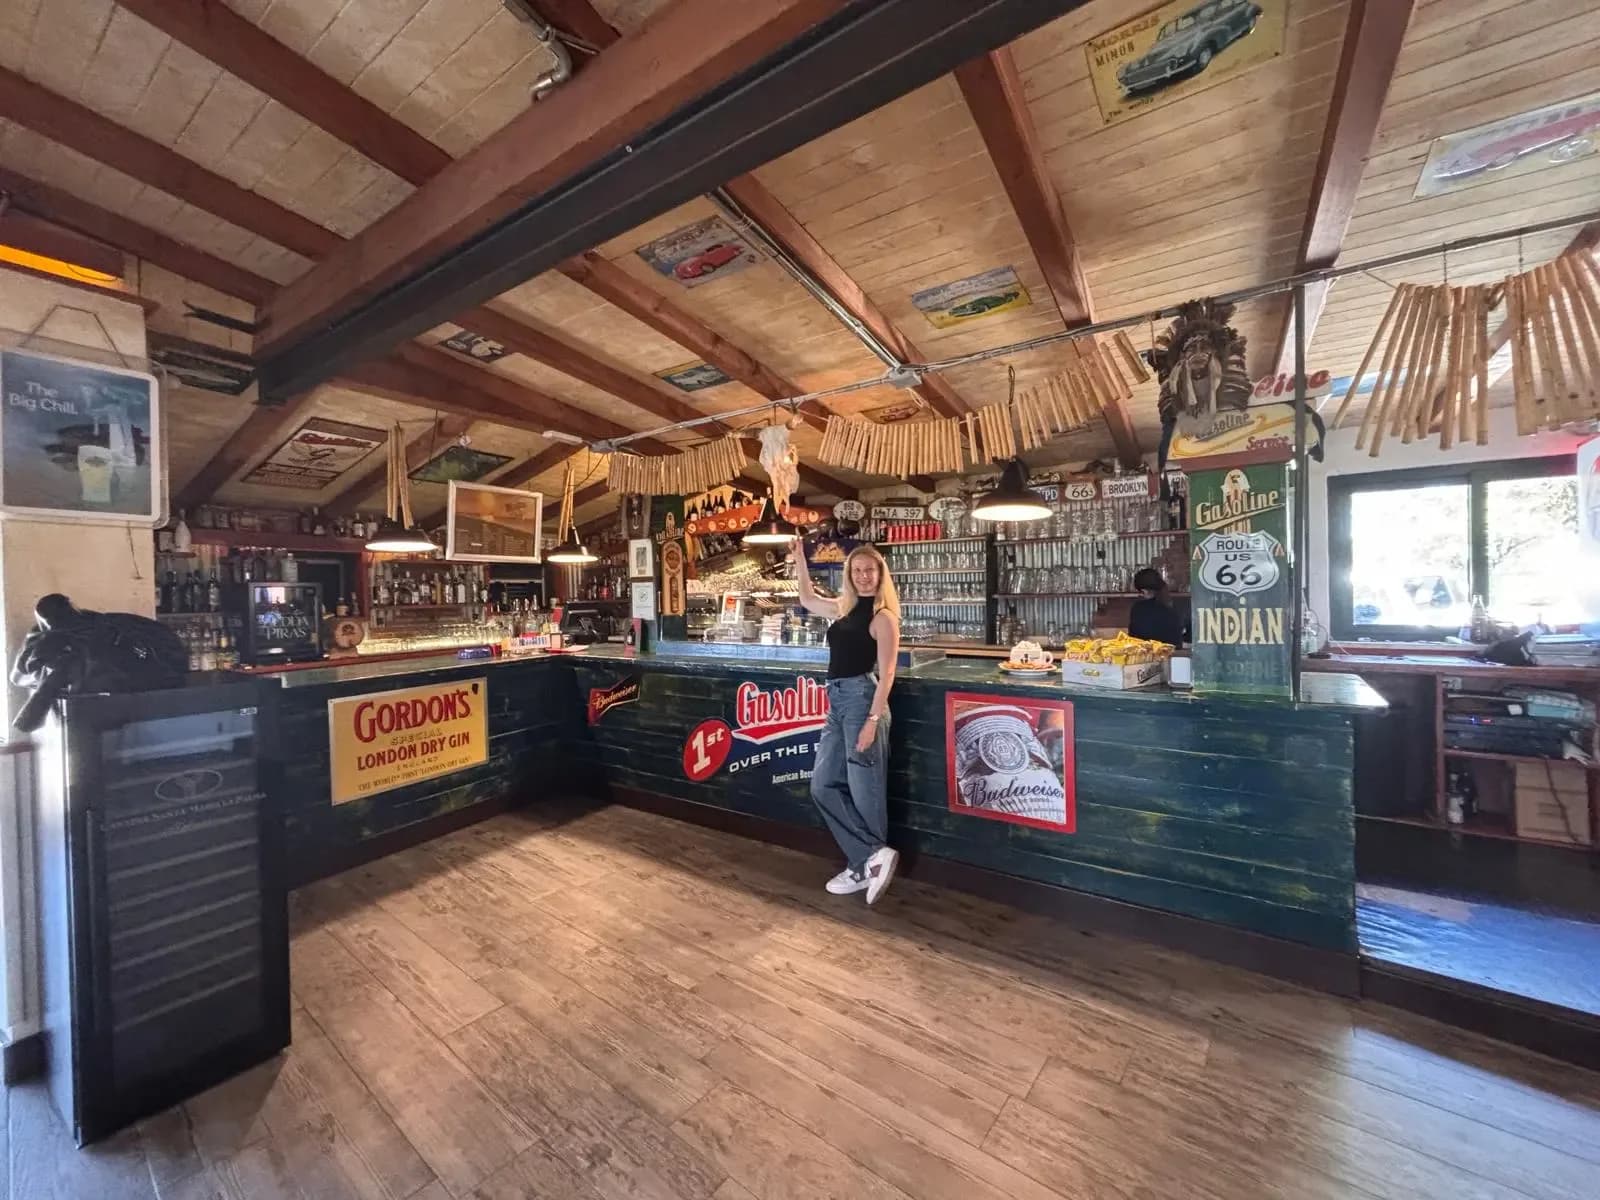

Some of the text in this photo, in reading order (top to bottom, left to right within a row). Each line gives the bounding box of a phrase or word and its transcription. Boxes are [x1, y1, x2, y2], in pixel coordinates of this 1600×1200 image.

[1095, 41, 1135, 67] MINOR
[9, 392, 36, 411] Big
[25, 381, 58, 398] The
[1108, 482, 1147, 495] BROOKLYN
[903, 508, 921, 519] 397
[1196, 490, 1279, 525] Gasoline
[1224, 553, 1252, 562] US
[1216, 564, 1262, 586] 66
[1197, 597, 1285, 645] INDIAN
[592, 684, 637, 710] Budweiser
[737, 676, 830, 729] Gasolin
[354, 689, 471, 743] GORDON'S
[357, 732, 470, 771] LONDON DRY GIN
[692, 727, 725, 774] 1st
[729, 752, 771, 773] OVER
[775, 744, 809, 758] THE
[772, 771, 799, 784] American
